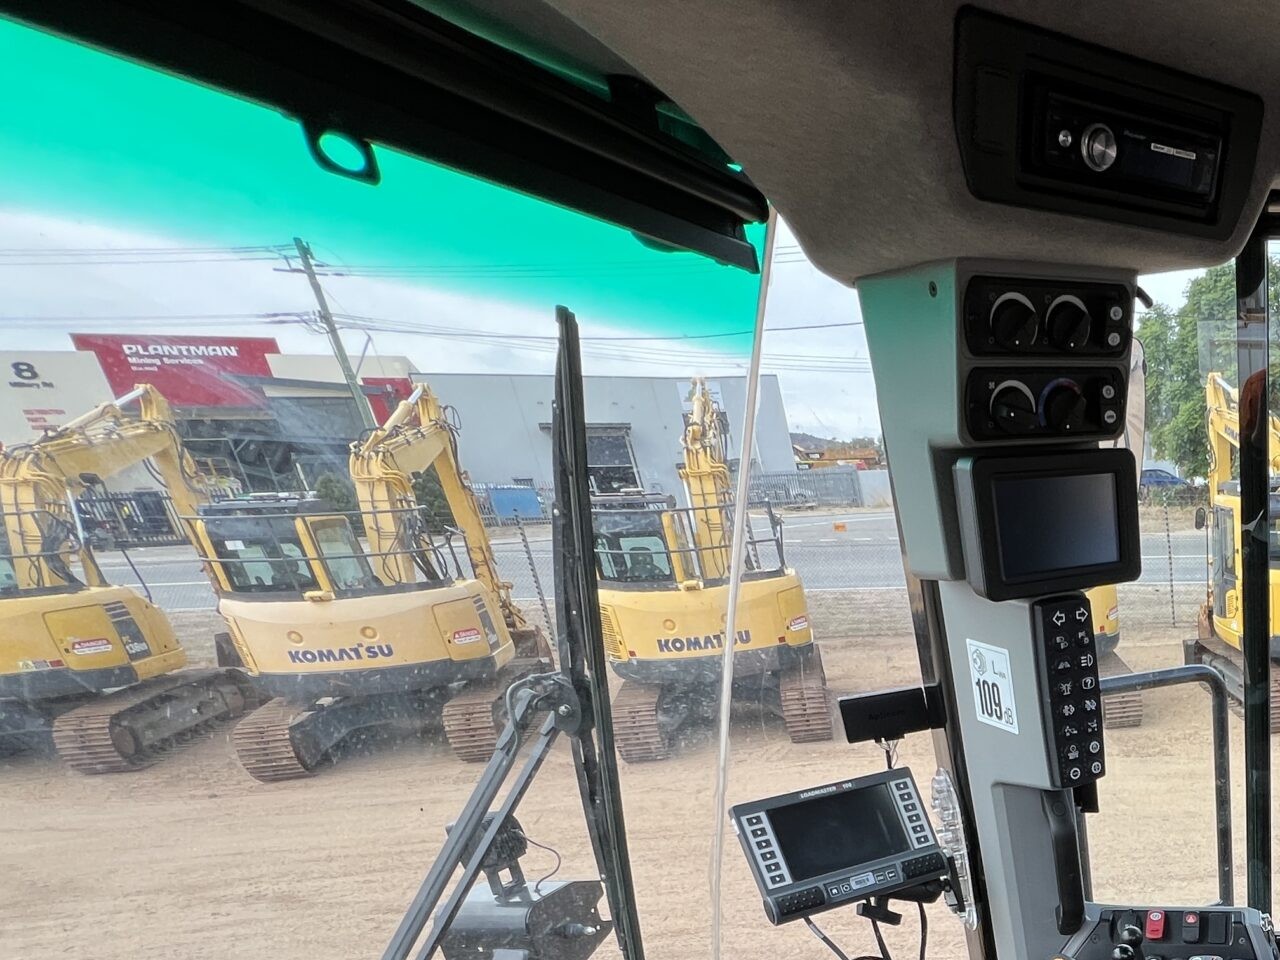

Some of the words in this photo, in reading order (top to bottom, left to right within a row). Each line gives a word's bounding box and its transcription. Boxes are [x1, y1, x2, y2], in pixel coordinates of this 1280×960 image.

[122, 344, 238, 356] PLANTMAN
[11, 361, 39, 380] 8
[127, 357, 161, 366] Mining
[1224, 423, 1240, 441] KOM
[656, 630, 752, 653] KOMATU
[287, 643, 394, 664] KOMATSU
[976, 678, 1003, 721] 109
[1004, 707, 1014, 726] dB
[800, 785, 837, 799] LOADMASTER
